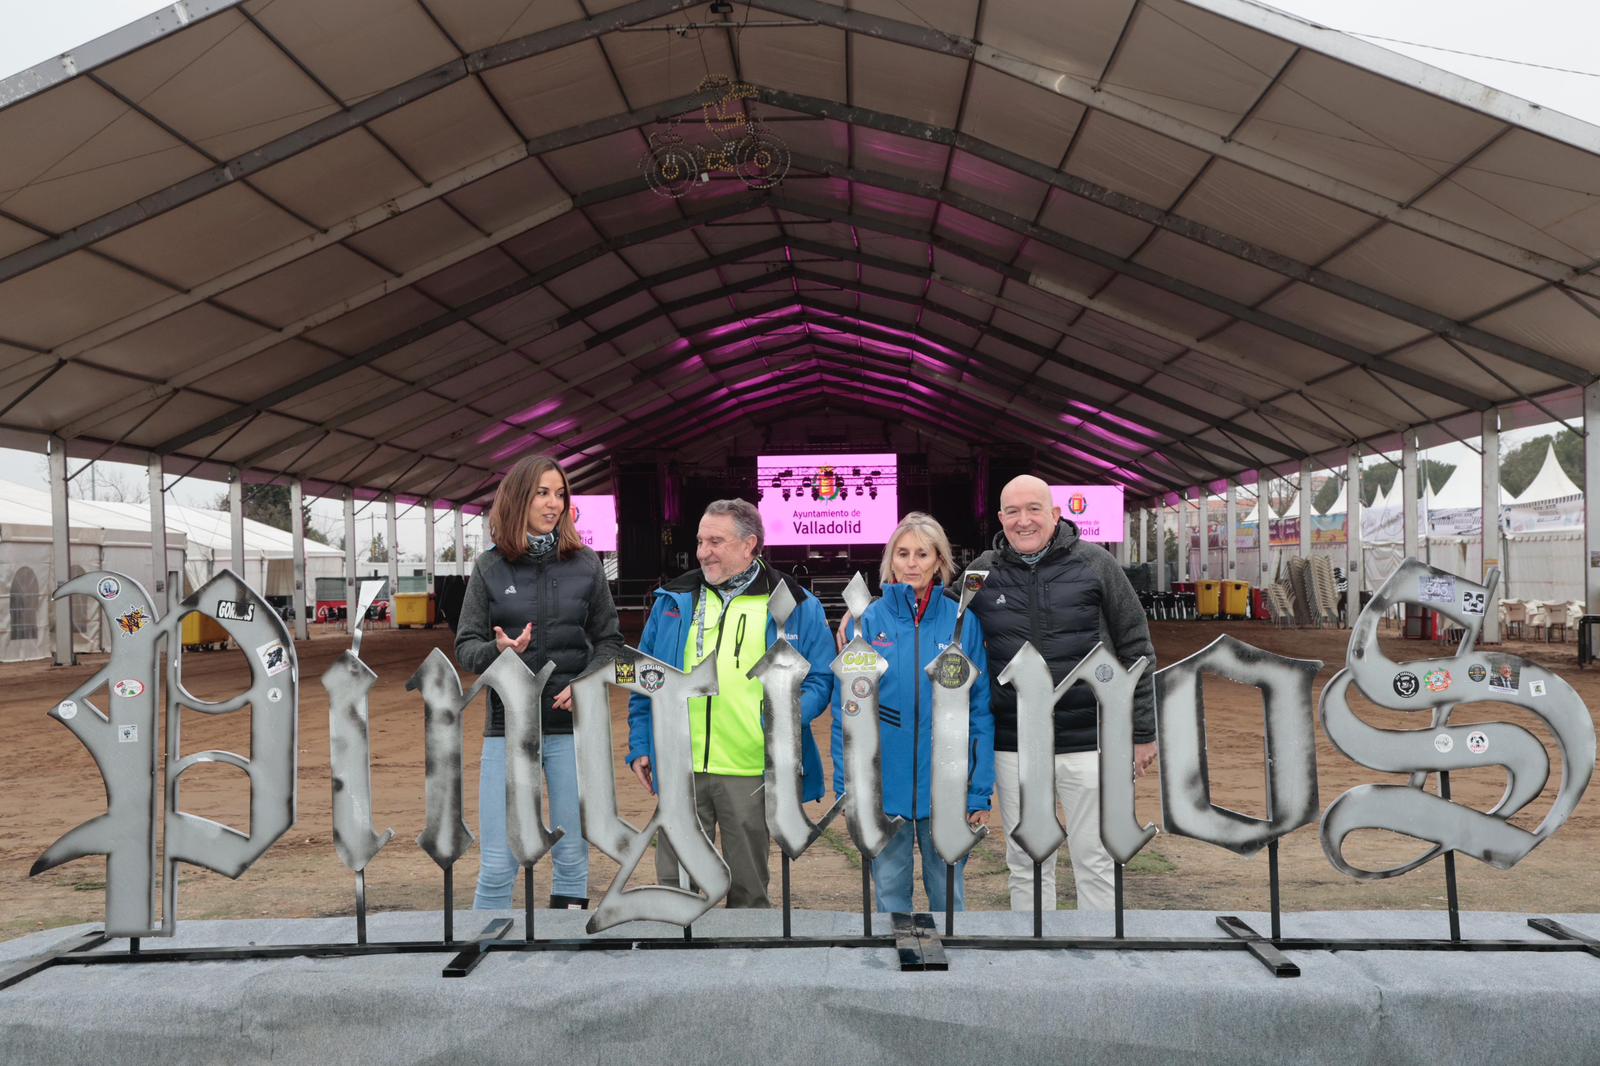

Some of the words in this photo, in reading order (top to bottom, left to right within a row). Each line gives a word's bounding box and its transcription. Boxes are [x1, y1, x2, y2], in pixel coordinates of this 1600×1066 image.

[793, 510, 849, 519] Ayuntamiento
[851, 509, 861, 517] de
[793, 520, 861, 534] Valladolid
